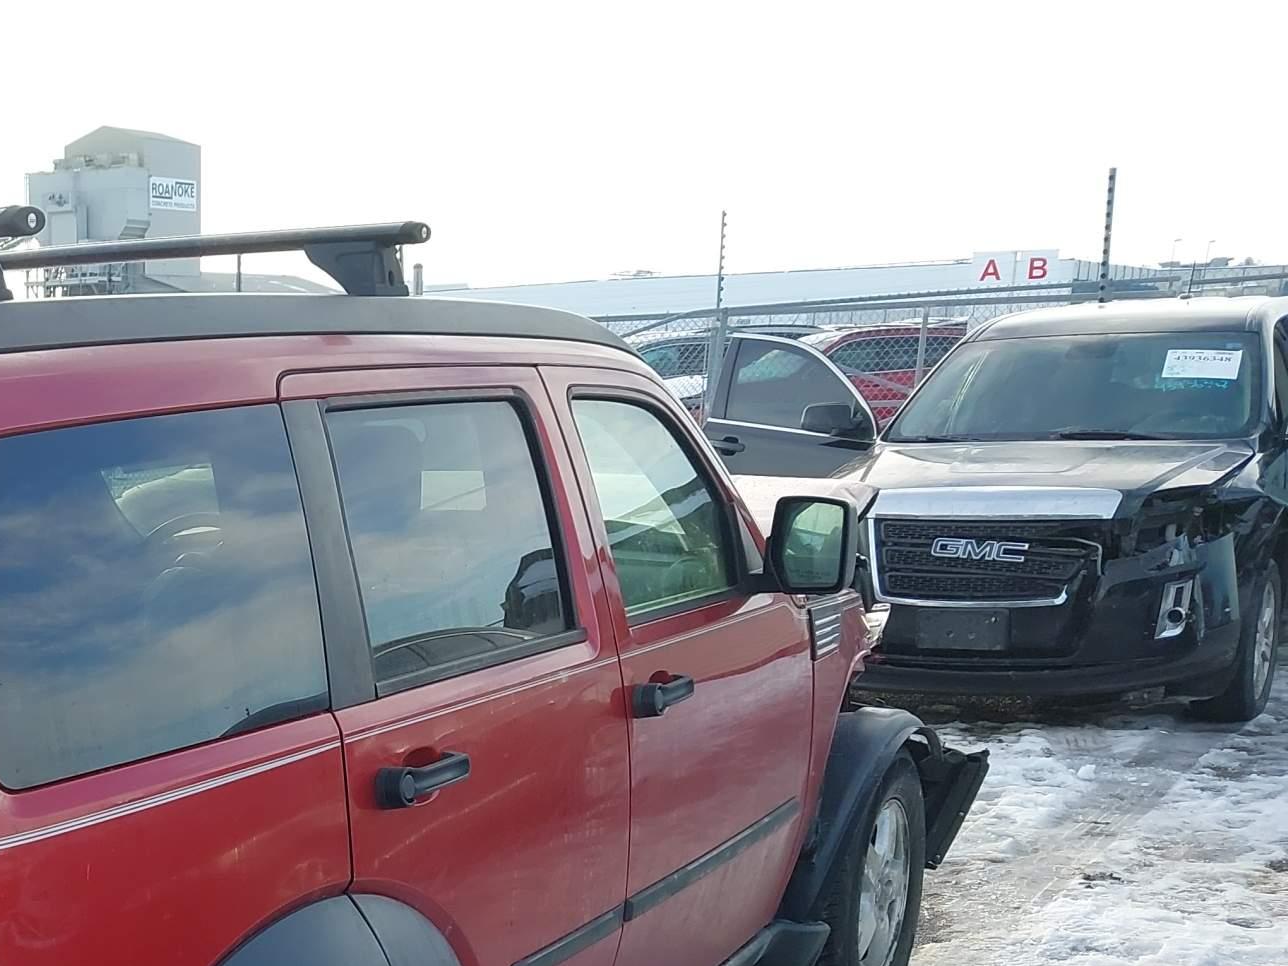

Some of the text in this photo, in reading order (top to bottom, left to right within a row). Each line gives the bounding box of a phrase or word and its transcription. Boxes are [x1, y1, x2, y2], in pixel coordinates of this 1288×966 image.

[152, 181, 195, 199] ROANOKE
[979, 258, 1001, 281] A
[1028, 257, 1048, 280] B
[930, 537, 1030, 562] GMC
